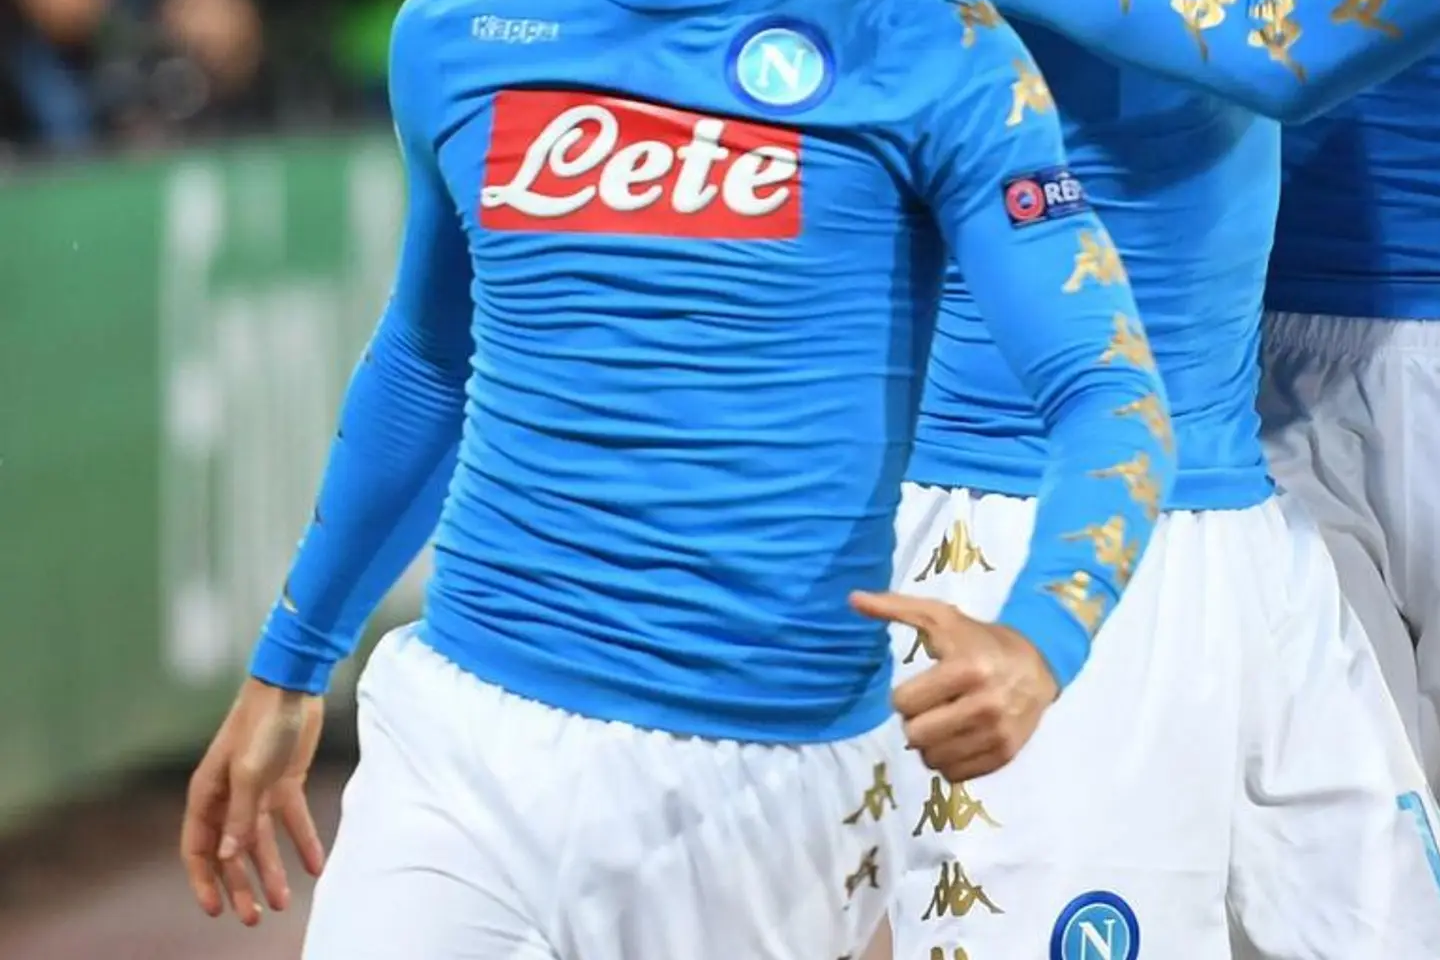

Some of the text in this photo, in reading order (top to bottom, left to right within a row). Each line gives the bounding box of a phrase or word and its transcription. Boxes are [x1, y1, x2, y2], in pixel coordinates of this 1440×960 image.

[472, 15, 560, 44] Kappa
[755, 43, 807, 90] N
[479, 104, 799, 217] Lete
[1078, 918, 1117, 960] N
